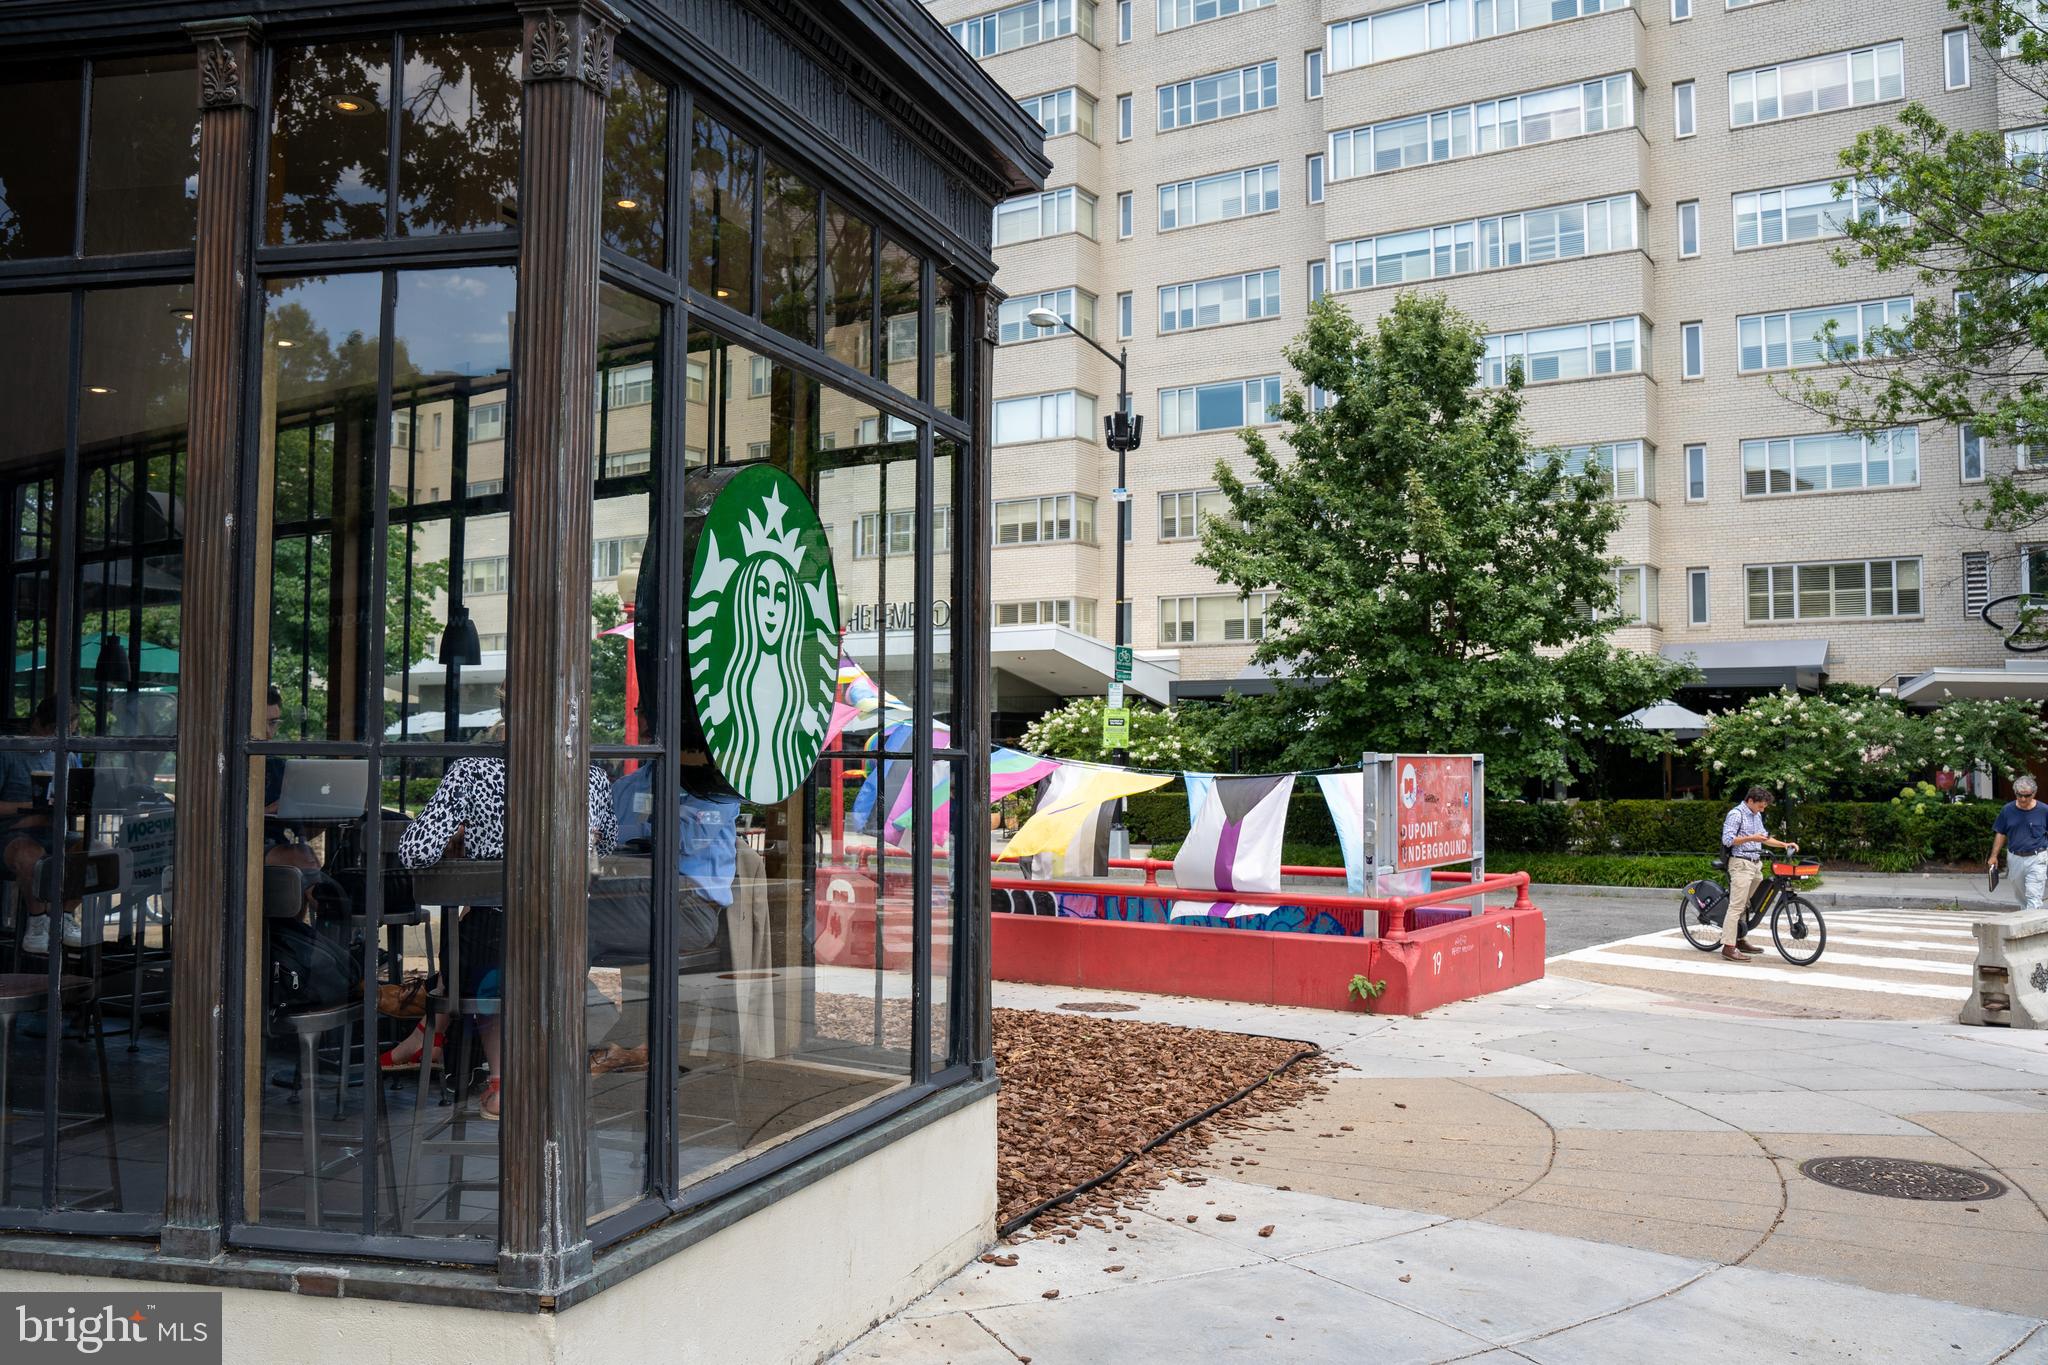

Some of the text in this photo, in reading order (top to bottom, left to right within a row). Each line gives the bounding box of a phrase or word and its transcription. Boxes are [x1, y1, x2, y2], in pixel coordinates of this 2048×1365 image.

[1401, 821, 1438, 841] DUPONT
[1401, 839, 1467, 864] UNDERGROUND
[1432, 951, 1442, 976] 19
